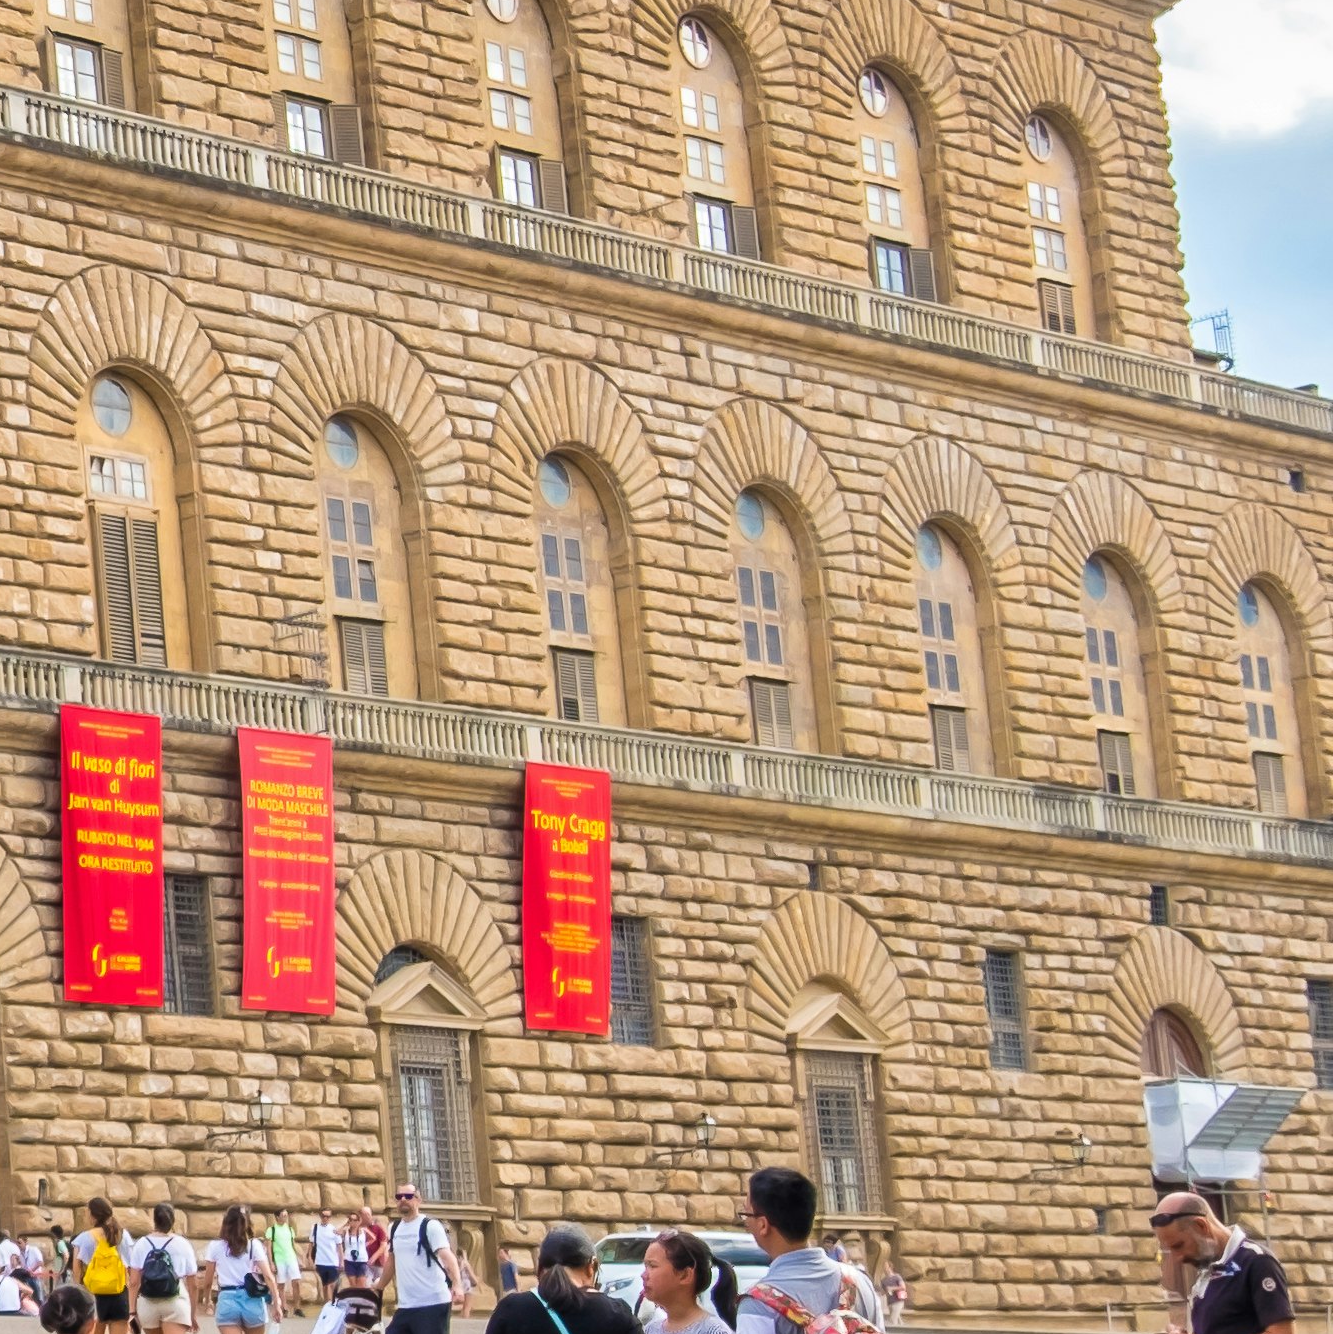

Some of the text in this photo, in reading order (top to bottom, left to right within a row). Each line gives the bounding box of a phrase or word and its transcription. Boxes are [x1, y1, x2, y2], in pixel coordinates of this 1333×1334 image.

[71, 751, 155, 781] Il vaso di fiori
[109, 779, 120, 793] di
[250, 779, 323, 800] ROMANZO BREVE
[68, 793, 159, 818] Jan van Huysum
[257, 797, 283, 812] MODA
[286, 801, 328, 817] MASCHILE
[531, 810, 605, 841] Tony Cragg
[77, 829, 154, 851] RUBATO NEL 1944
[79, 855, 153, 874] ORA RESTITUITO
